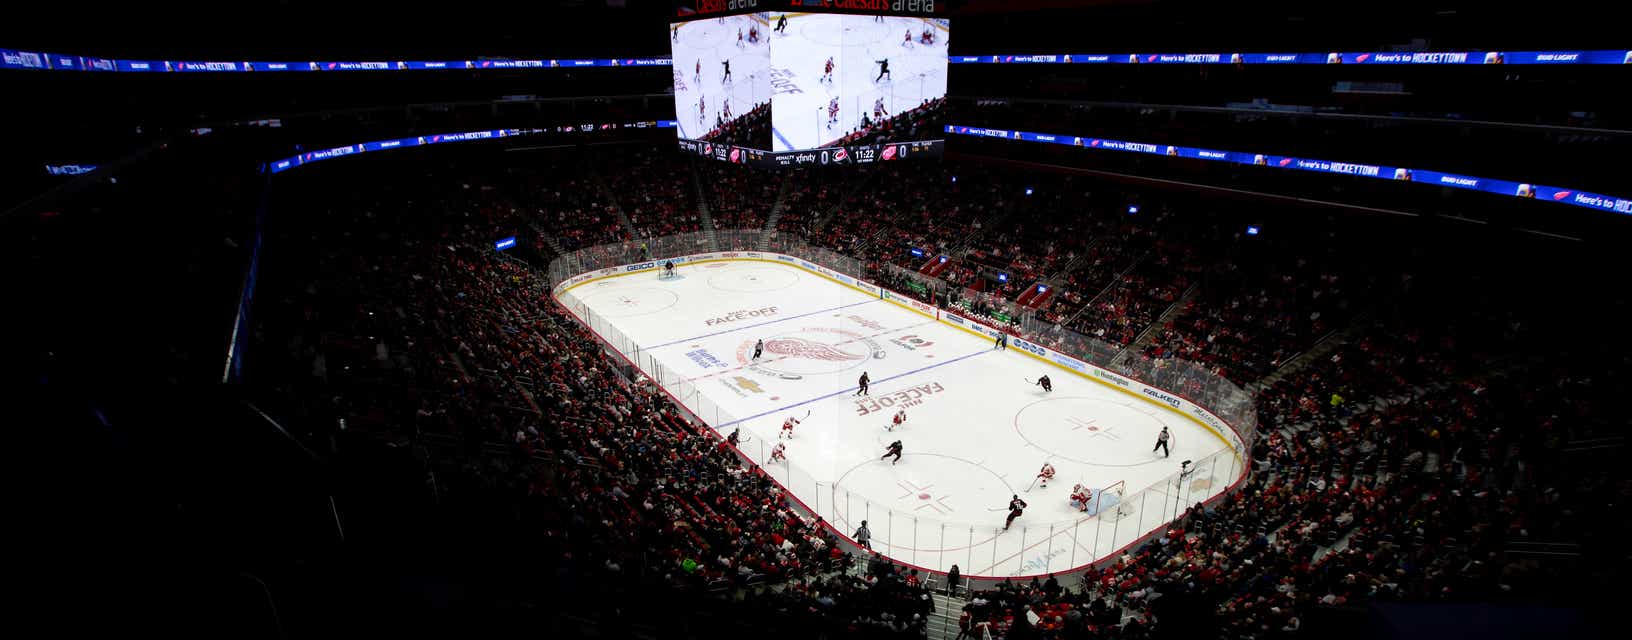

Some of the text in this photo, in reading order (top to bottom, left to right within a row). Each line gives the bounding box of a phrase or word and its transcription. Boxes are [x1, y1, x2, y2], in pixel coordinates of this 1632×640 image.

[892, 0, 934, 12] arena
[1185, 54, 1220, 63] HOCKEYTOWN
[1375, 54, 1401, 62] Here's
[1412, 53, 1467, 64] HOCKEYTOWN
[1554, 54, 1578, 62] LIGHT
[821, 151, 829, 165] 0
[855, 149, 874, 159] 11:22
[900, 145, 907, 159] 0
[795, 153, 816, 164] xfinity
[1297, 159, 1380, 176] Here's to HOCKEYTOWN
[1457, 178, 1478, 187] LIGHT
[1575, 193, 1602, 206] Here's
[1603, 199, 1614, 208] to
[626, 262, 655, 272] GEICO
[705, 306, 777, 326] FACE-OFF
[856, 382, 945, 416] FACE-OFF
[1143, 388, 1181, 406] FALKEN
